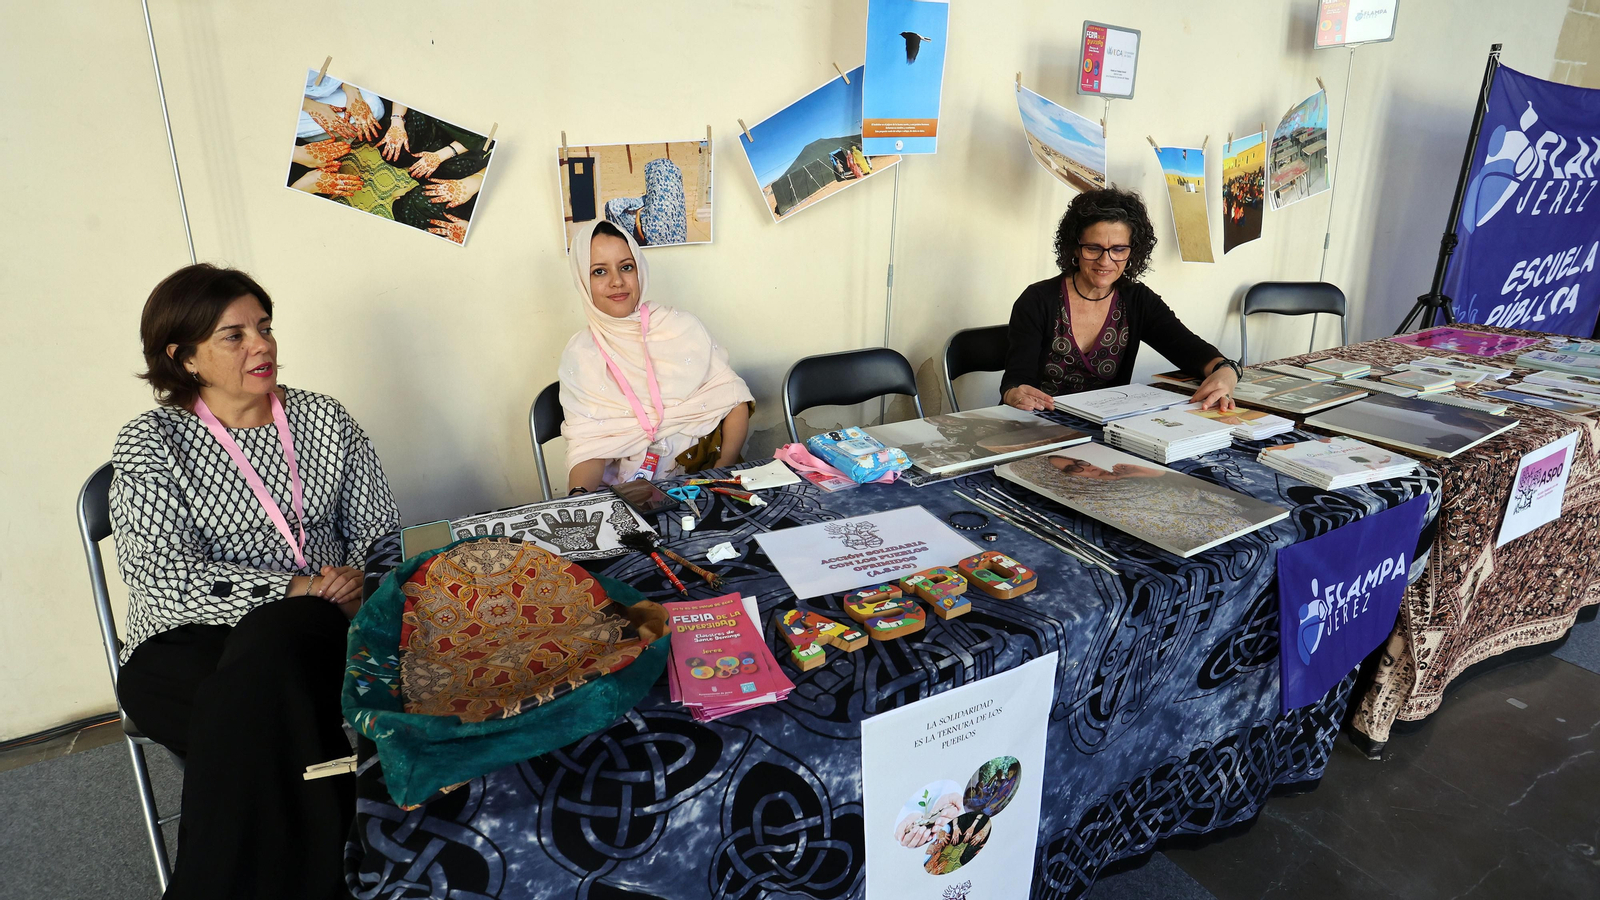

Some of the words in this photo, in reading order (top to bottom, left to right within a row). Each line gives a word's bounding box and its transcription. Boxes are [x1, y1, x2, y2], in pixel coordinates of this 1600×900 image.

[1516, 180, 1598, 215] JEREZ
[1501, 241, 1599, 295] ESCUELA
[1484, 283, 1580, 328] PÚBLICA
[1539, 463, 1564, 487] ASPO
[821, 552, 864, 565] ACCIÓN
[865, 540, 927, 556] SOLIDARIA
[828, 560, 854, 570] CON
[855, 556, 878, 565] LOS
[878, 546, 929, 560] PUEBLOS
[853, 555, 918, 572] OPRIMIDOS
[1325, 552, 1406, 616] FLAMPA
[672, 613, 714, 624] FERIA
[776, 551, 1038, 672] ASPO
[1327, 592, 1371, 636] JEREZ
[677, 619, 737, 633] DIVERSIDAD
[715, 633, 741, 641] Domingo
[914, 739, 924, 748] ES
[925, 732, 936, 744] LA
[936, 718, 975, 739] TERNURA
[975, 714, 987, 724] DE
[987, 706, 1003, 719] LOS
[926, 721, 937, 730] LA
[939, 699, 994, 726] SOLIDARIDAD
[941, 730, 977, 749] PUEBLOS
